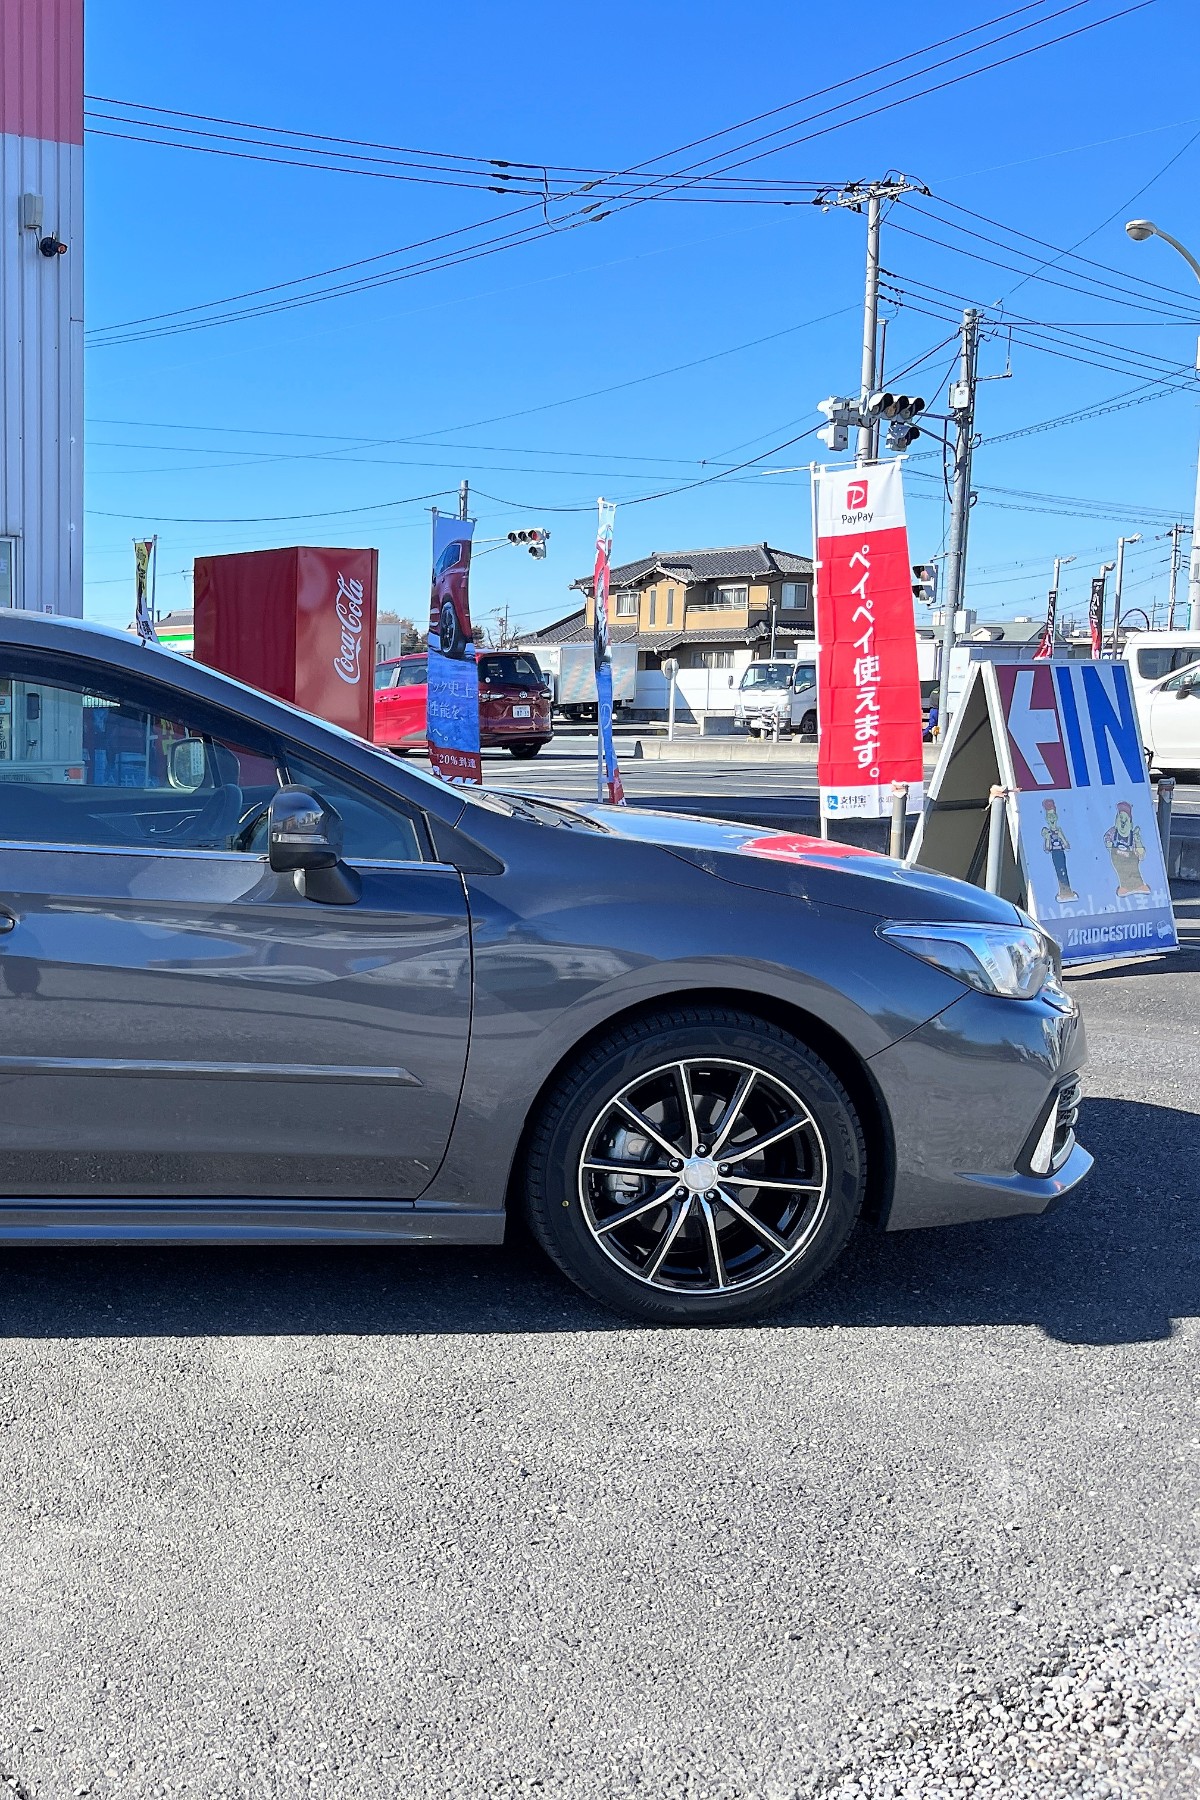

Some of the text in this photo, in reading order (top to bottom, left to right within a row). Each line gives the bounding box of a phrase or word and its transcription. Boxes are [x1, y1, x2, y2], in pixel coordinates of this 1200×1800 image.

[841, 511, 874, 525] PayPay
[334, 570, 363, 684] Coca-Cola
[849, 544, 882, 778] ペイペイ使えます。
[1056, 665, 1145, 787] IN
[1067, 921, 1153, 947] BRIDGESTONE
